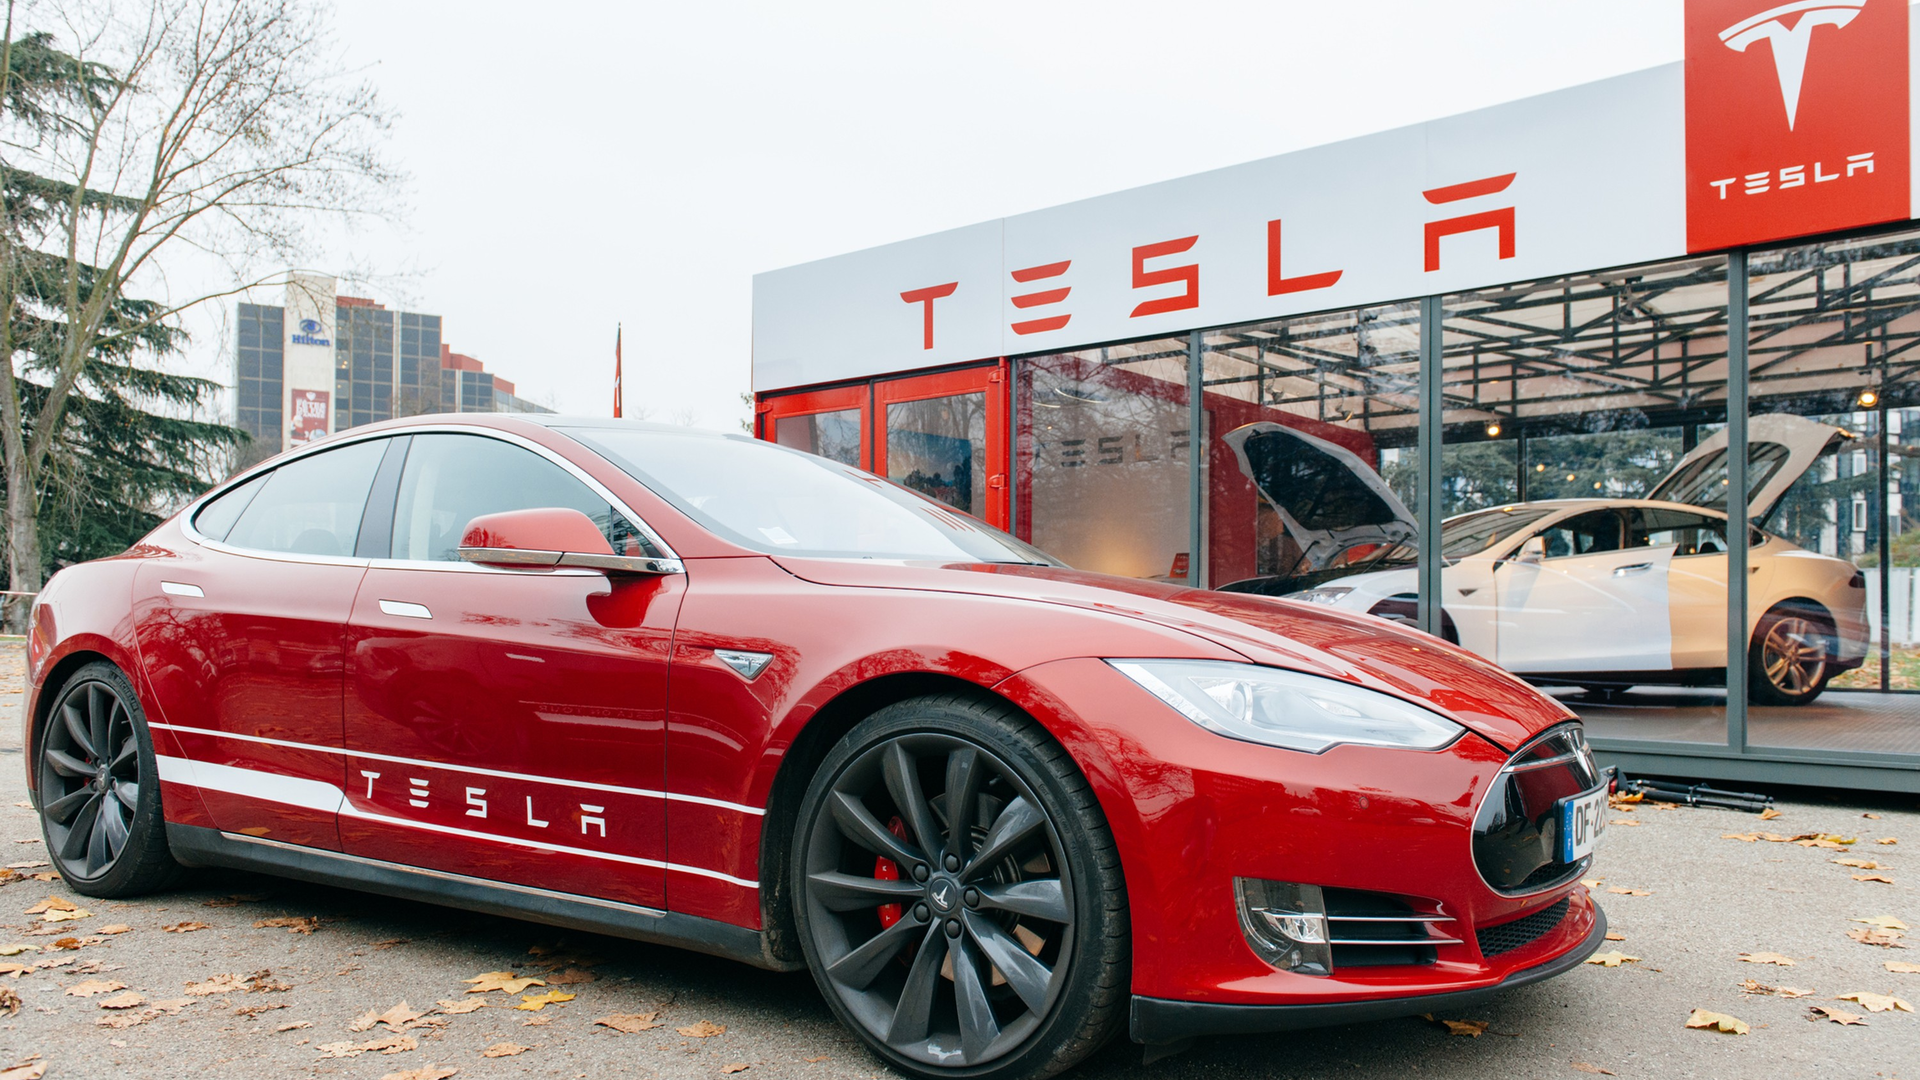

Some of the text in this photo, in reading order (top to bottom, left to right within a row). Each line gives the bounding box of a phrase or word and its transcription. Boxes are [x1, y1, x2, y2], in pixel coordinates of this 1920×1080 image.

[1709, 152, 1875, 200] TESLA
[900, 172, 1517, 350] TESLA
[291, 333, 330, 346] Hilton
[115, 677, 138, 710] MICHELIN
[360, 770, 606, 838] TESLA
